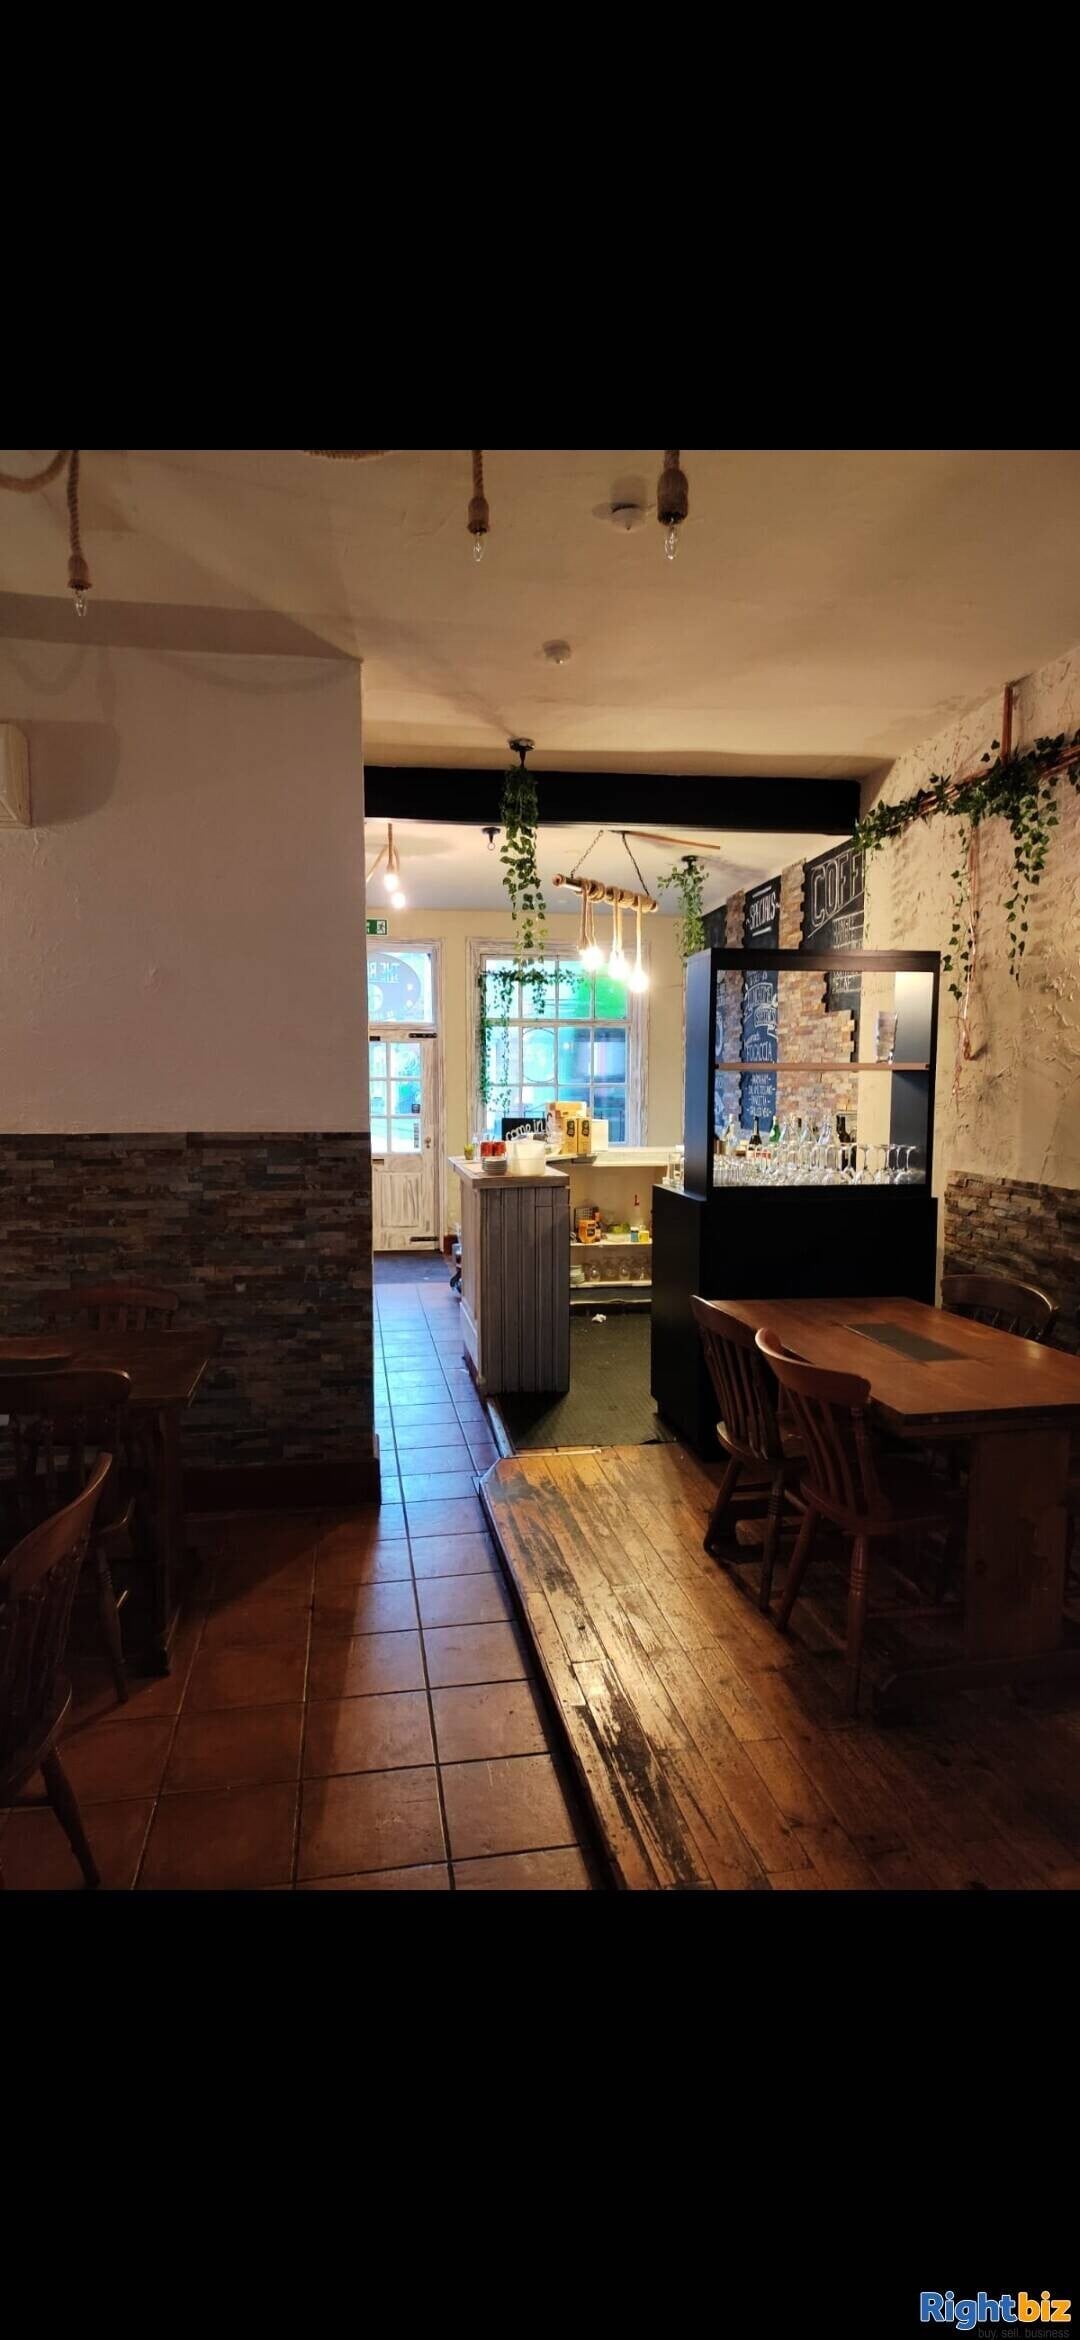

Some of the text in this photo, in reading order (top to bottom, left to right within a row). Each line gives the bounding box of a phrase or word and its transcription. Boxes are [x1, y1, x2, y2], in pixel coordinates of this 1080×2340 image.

[811, 848, 864, 928] COFF
[749, 891, 776, 930] SPECIALS
[506, 1124, 531, 1140] come
